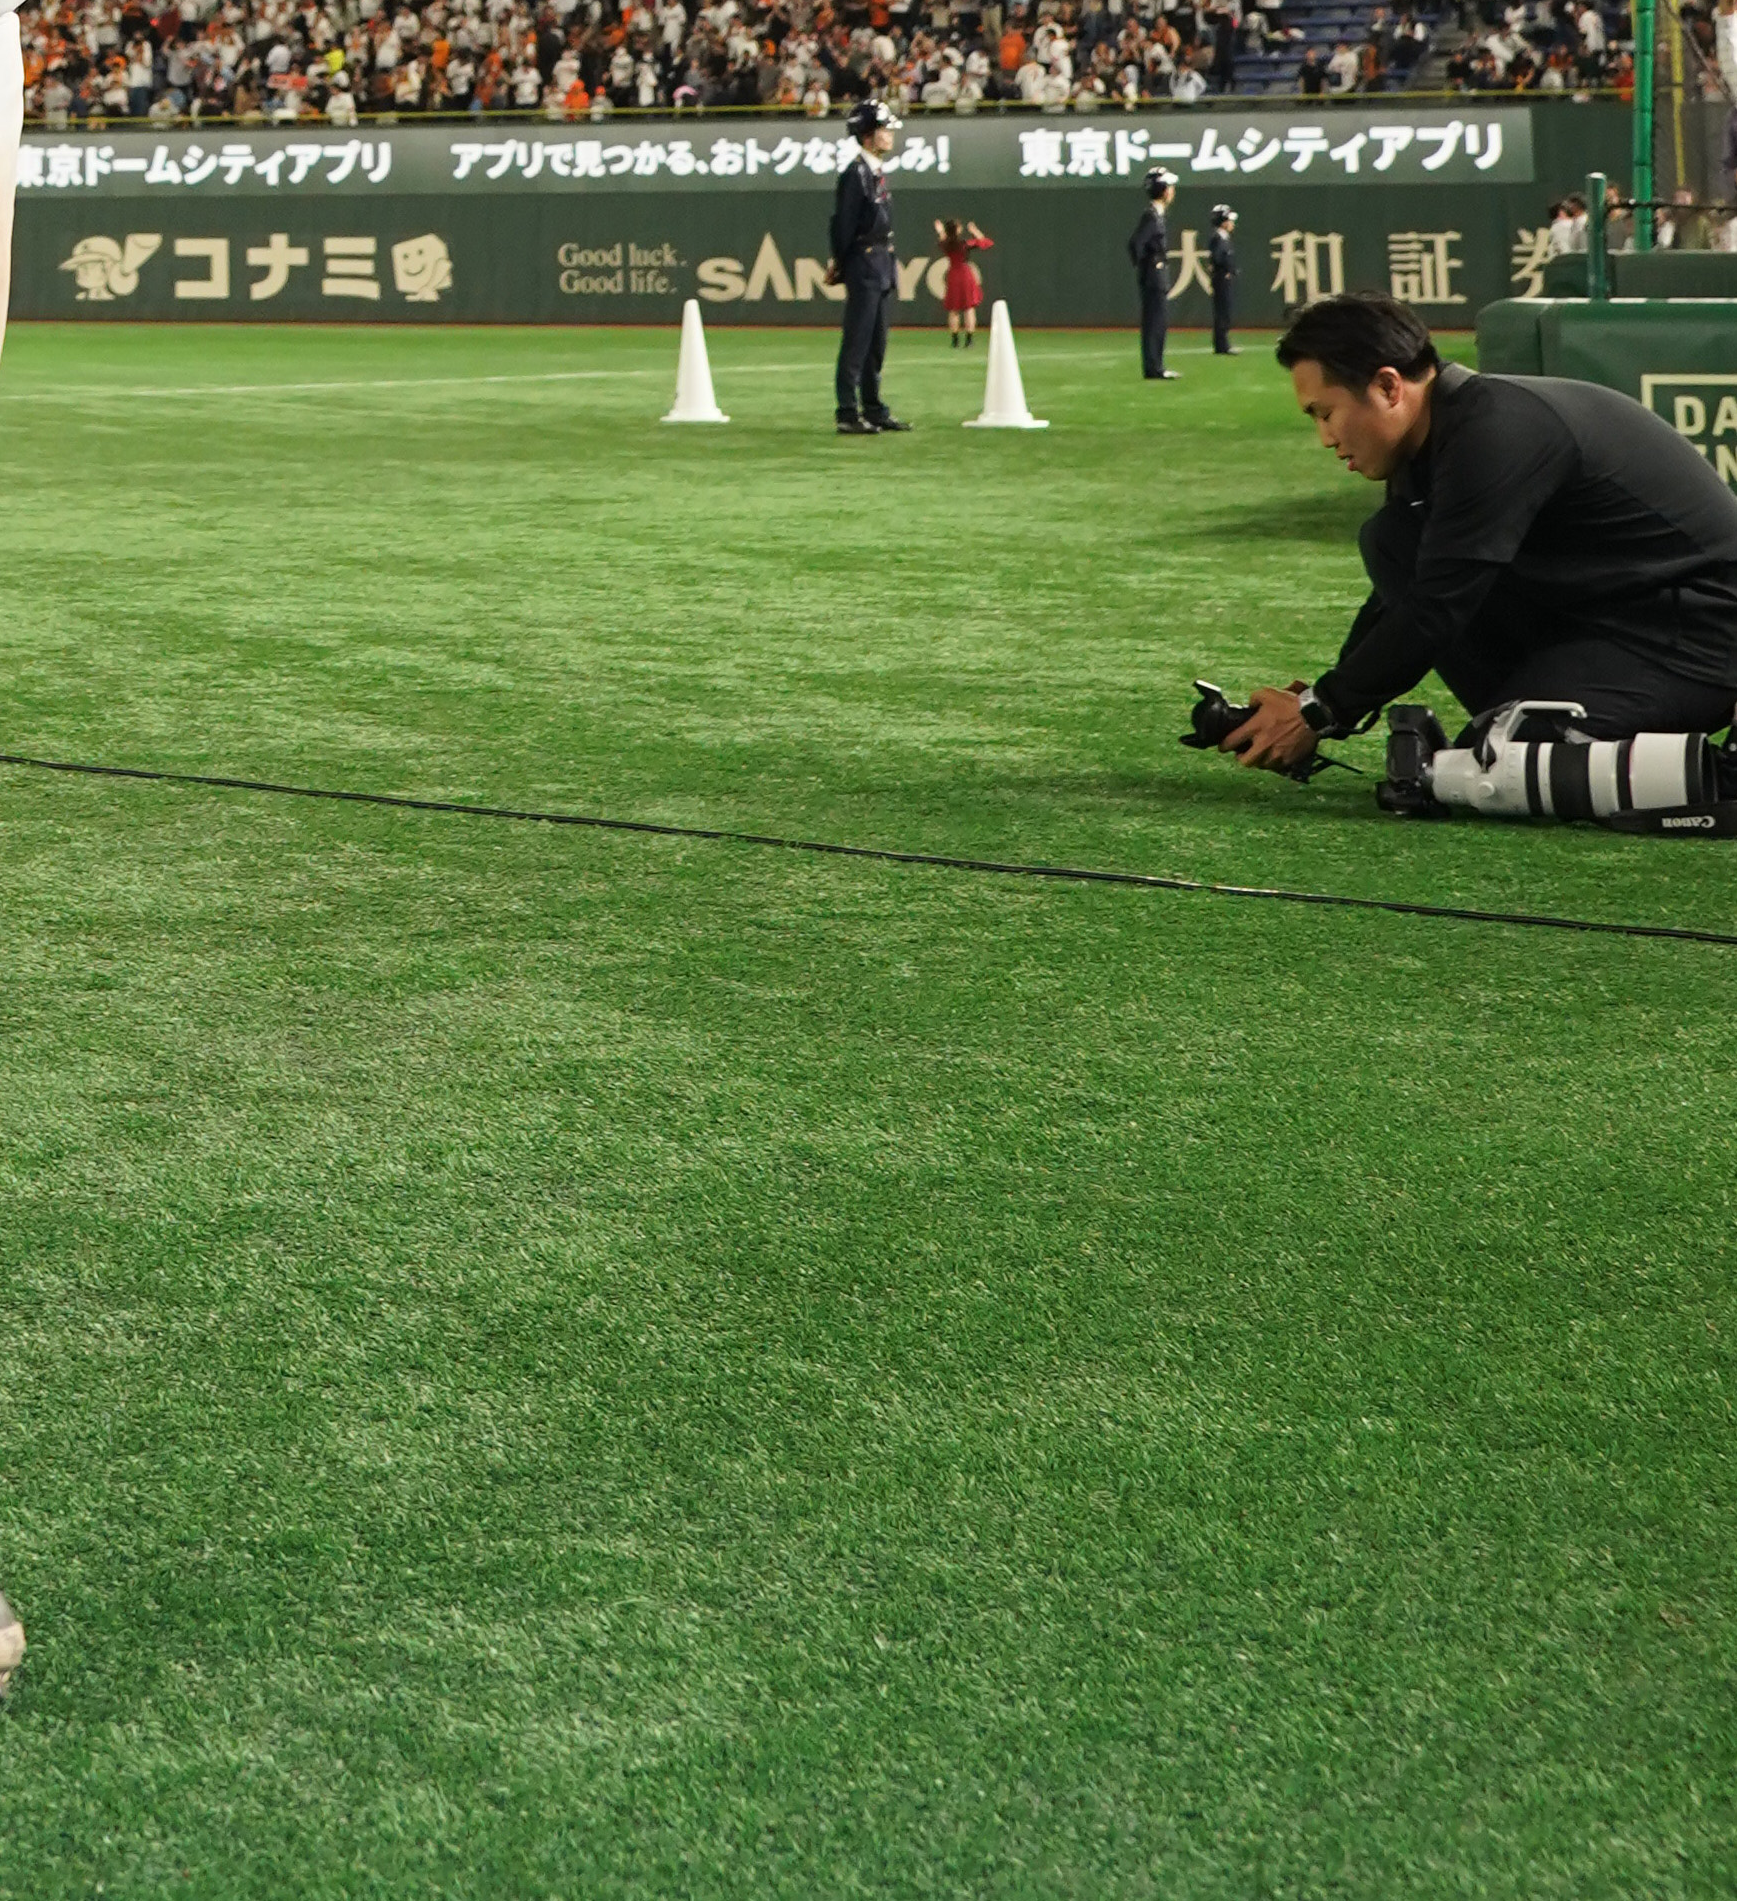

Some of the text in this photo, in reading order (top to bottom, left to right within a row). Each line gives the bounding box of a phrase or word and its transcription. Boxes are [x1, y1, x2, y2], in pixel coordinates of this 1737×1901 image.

[16, 139, 393, 187] 東京ドームシティアプリ
[1018, 121, 1503, 178] 東京ドームシティアプリ
[173, 233, 381, 301] コナミ
[558, 243, 689, 269] Good luck.
[559, 269, 679, 295] Good life.
[697, 232, 982, 301] SANYO
